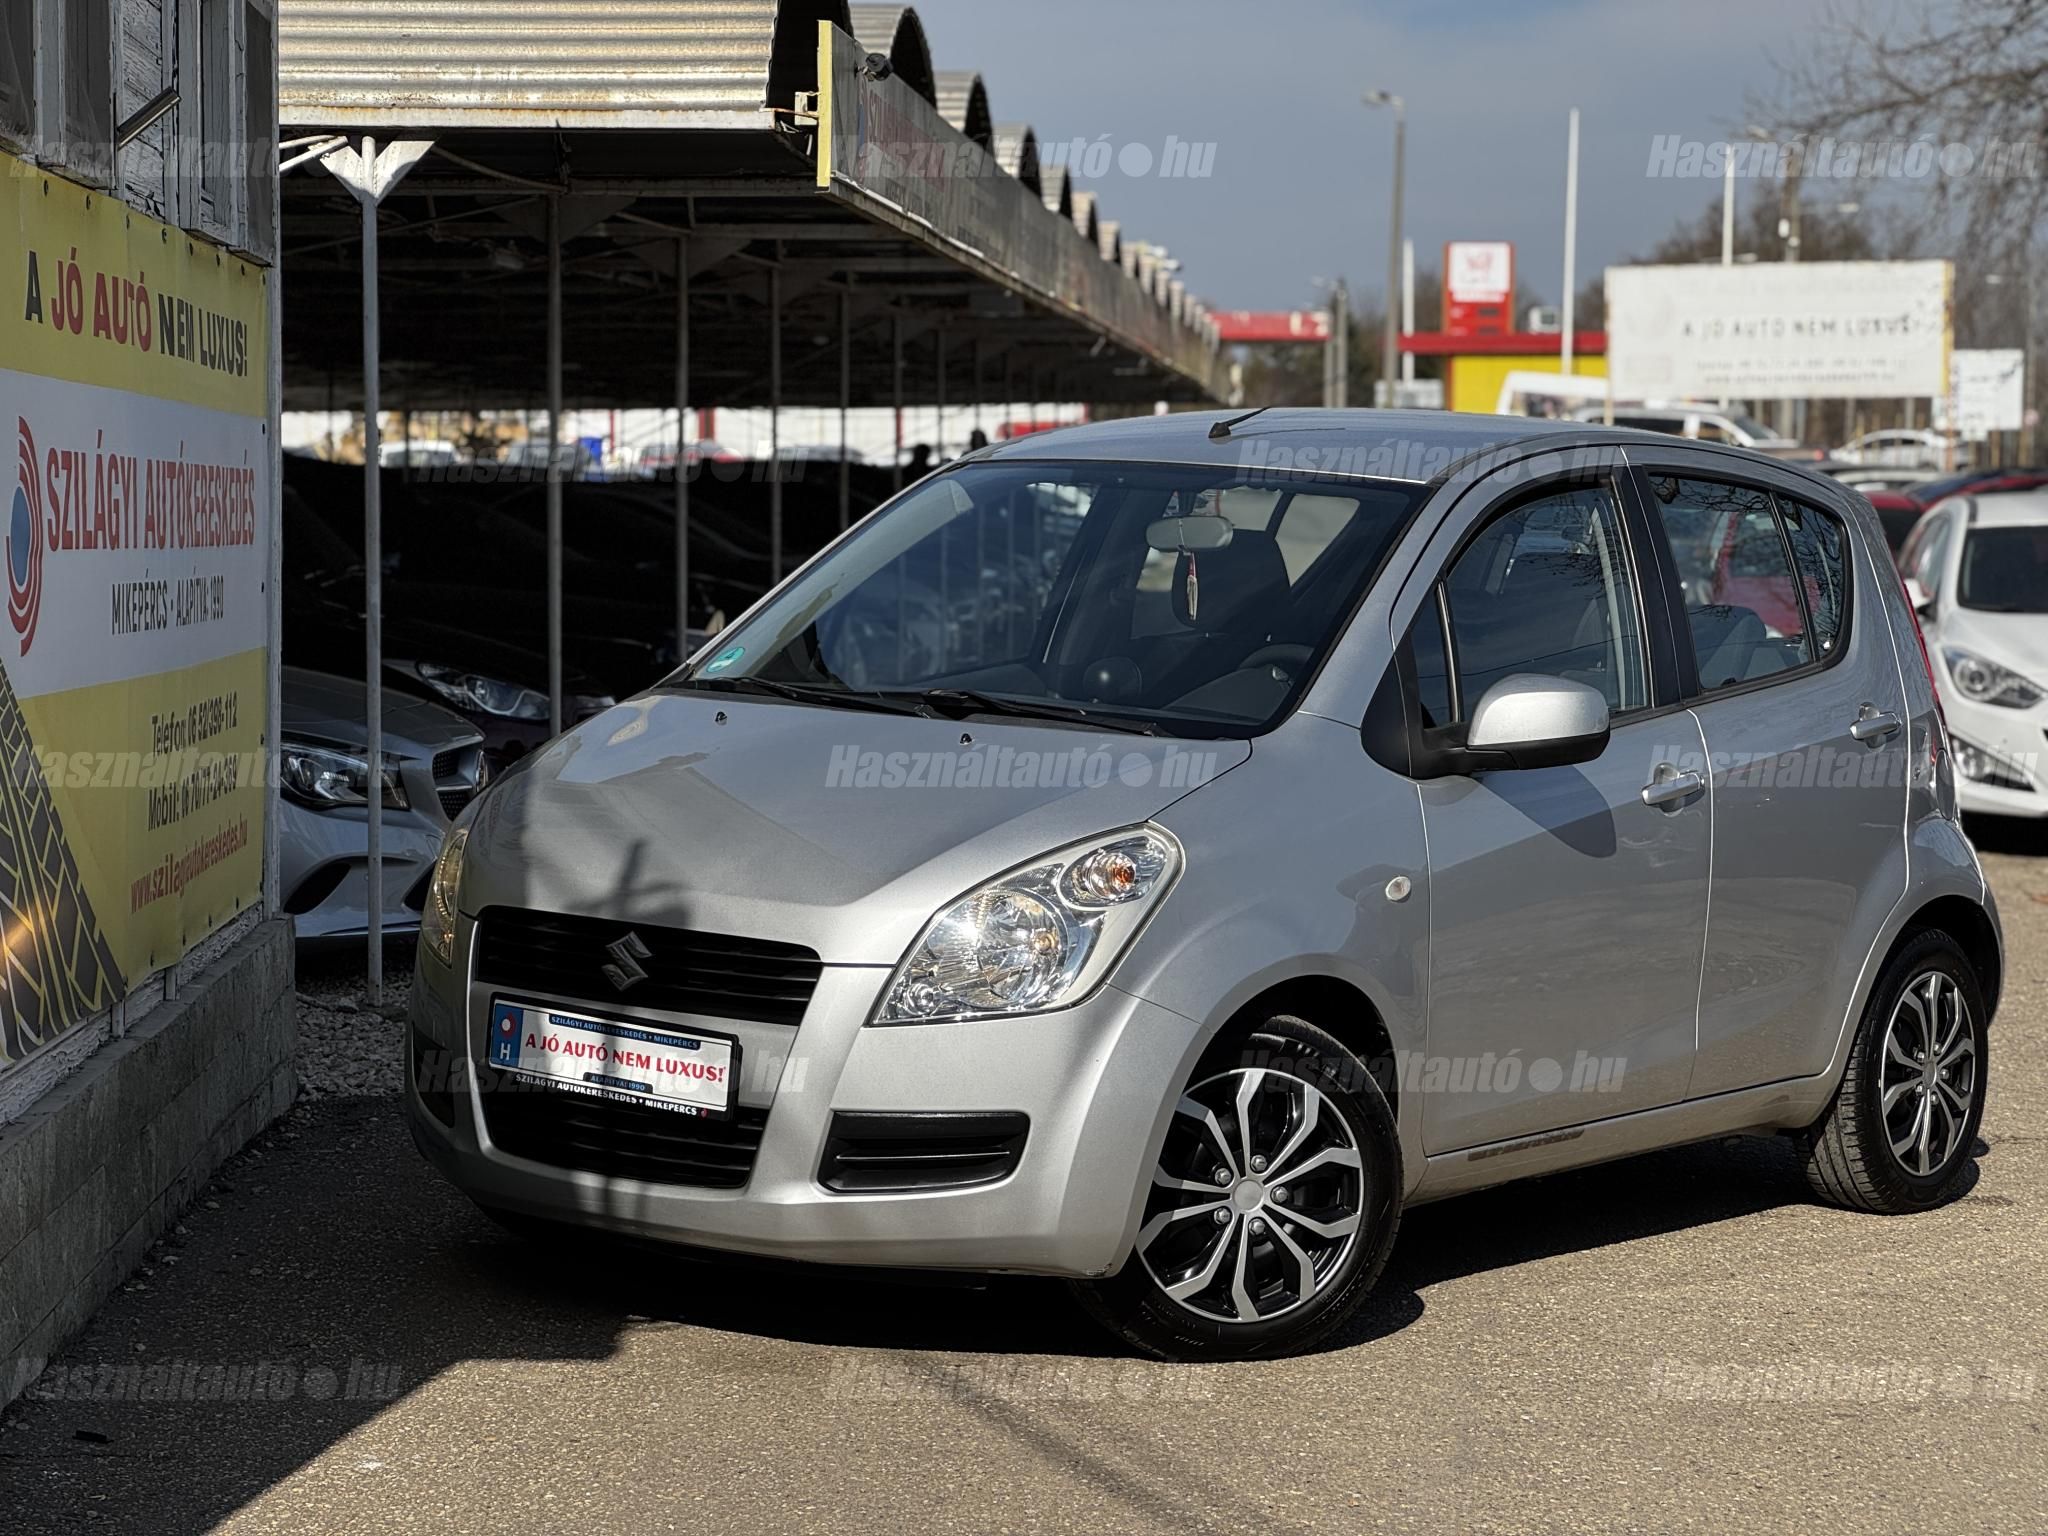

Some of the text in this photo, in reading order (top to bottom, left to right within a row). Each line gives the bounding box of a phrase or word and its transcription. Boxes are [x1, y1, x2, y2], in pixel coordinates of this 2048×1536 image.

[25, 247, 248, 378] A JÓ AUTÓ NEM LUXUS!
[47, 429, 255, 553] SZILÁGYI AUTÓKERESKEDÉS
[111, 568, 167, 635] MIKEPÉRCS
[147, 781, 180, 831] Mobil:
[499, 1043, 511, 1061] H
[525, 1033, 725, 1083] A JÓ AUTÓ NEM LUXUS!
